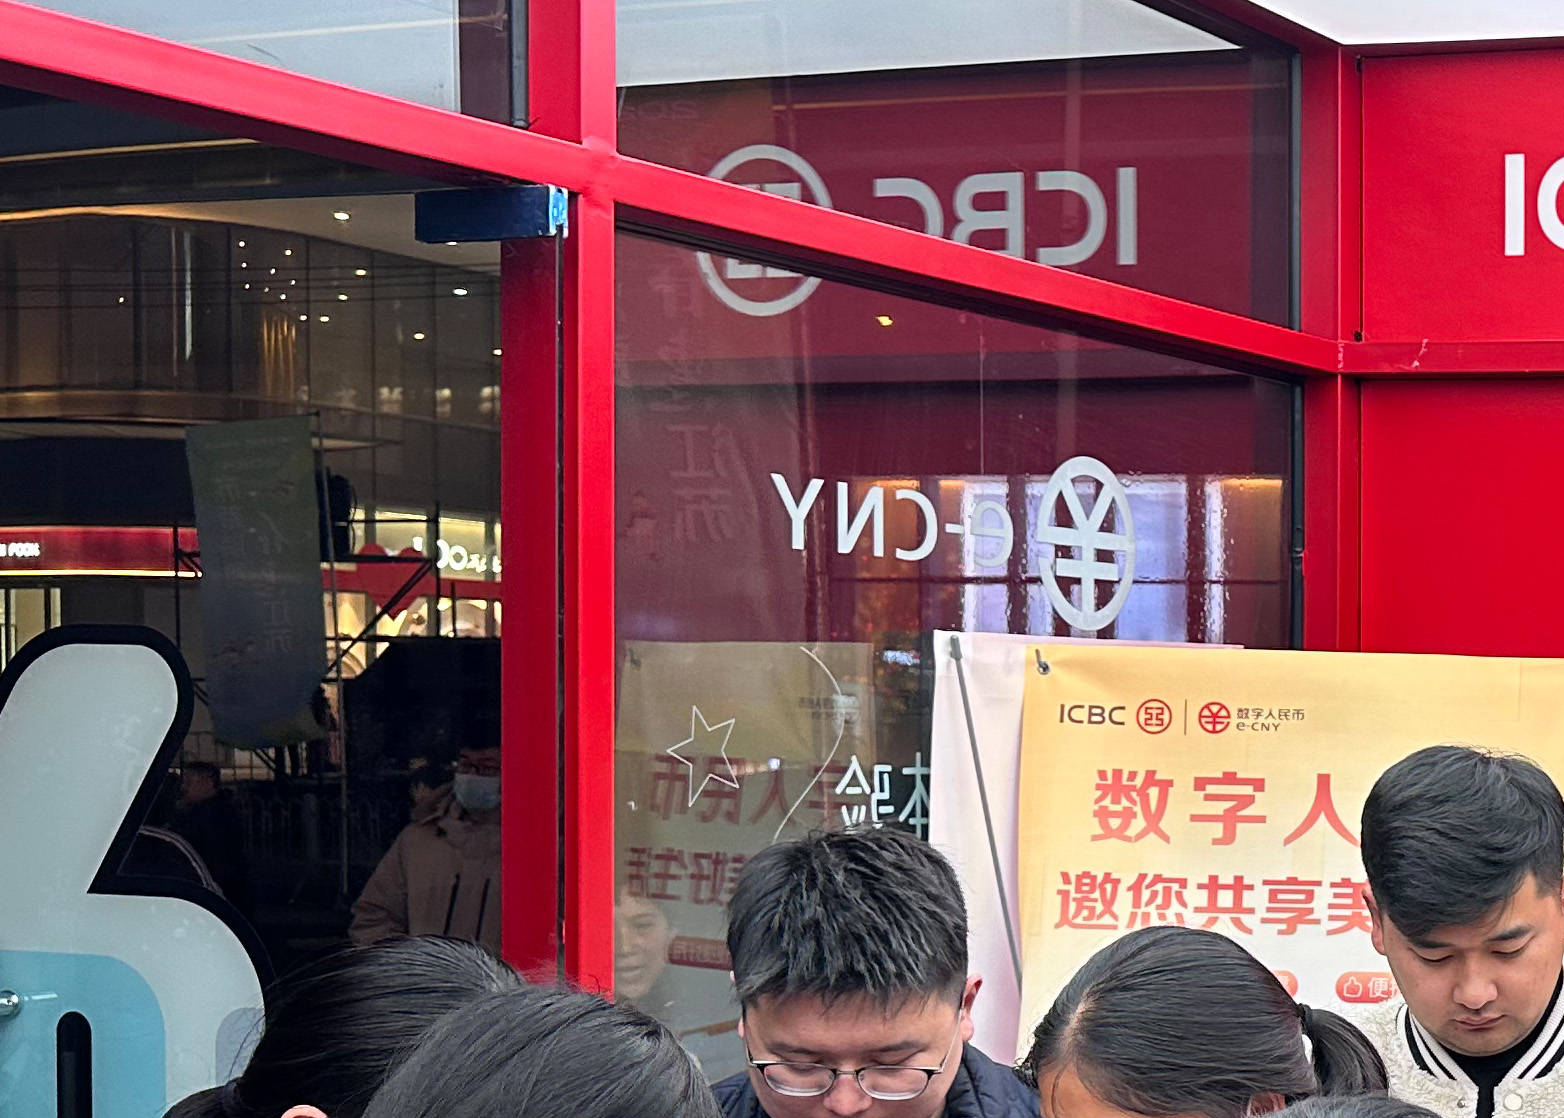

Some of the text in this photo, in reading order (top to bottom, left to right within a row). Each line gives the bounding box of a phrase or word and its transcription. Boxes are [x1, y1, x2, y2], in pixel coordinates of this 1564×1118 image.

[1059, 703, 1126, 726] ICBC
[1236, 707, 1305, 721] 数字人民币
[1236, 721, 1280, 732] e-CNY
[1091, 768, 1360, 848] 数字人
